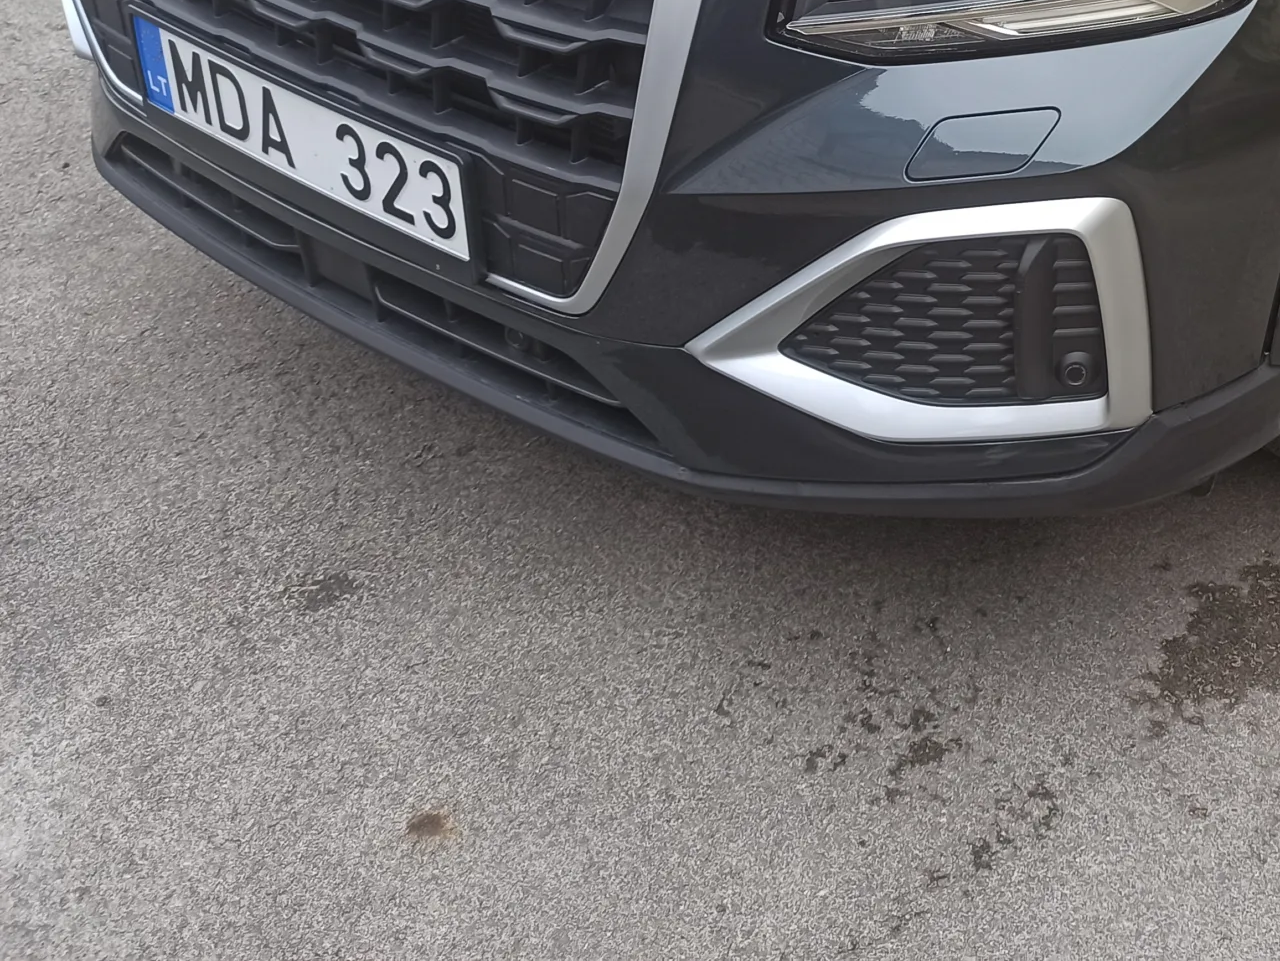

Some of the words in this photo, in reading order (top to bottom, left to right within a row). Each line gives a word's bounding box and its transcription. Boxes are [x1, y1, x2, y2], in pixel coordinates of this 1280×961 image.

[147, 69, 167, 97] LT
[168, 39, 296, 169] MDA
[336, 124, 456, 239] 323
